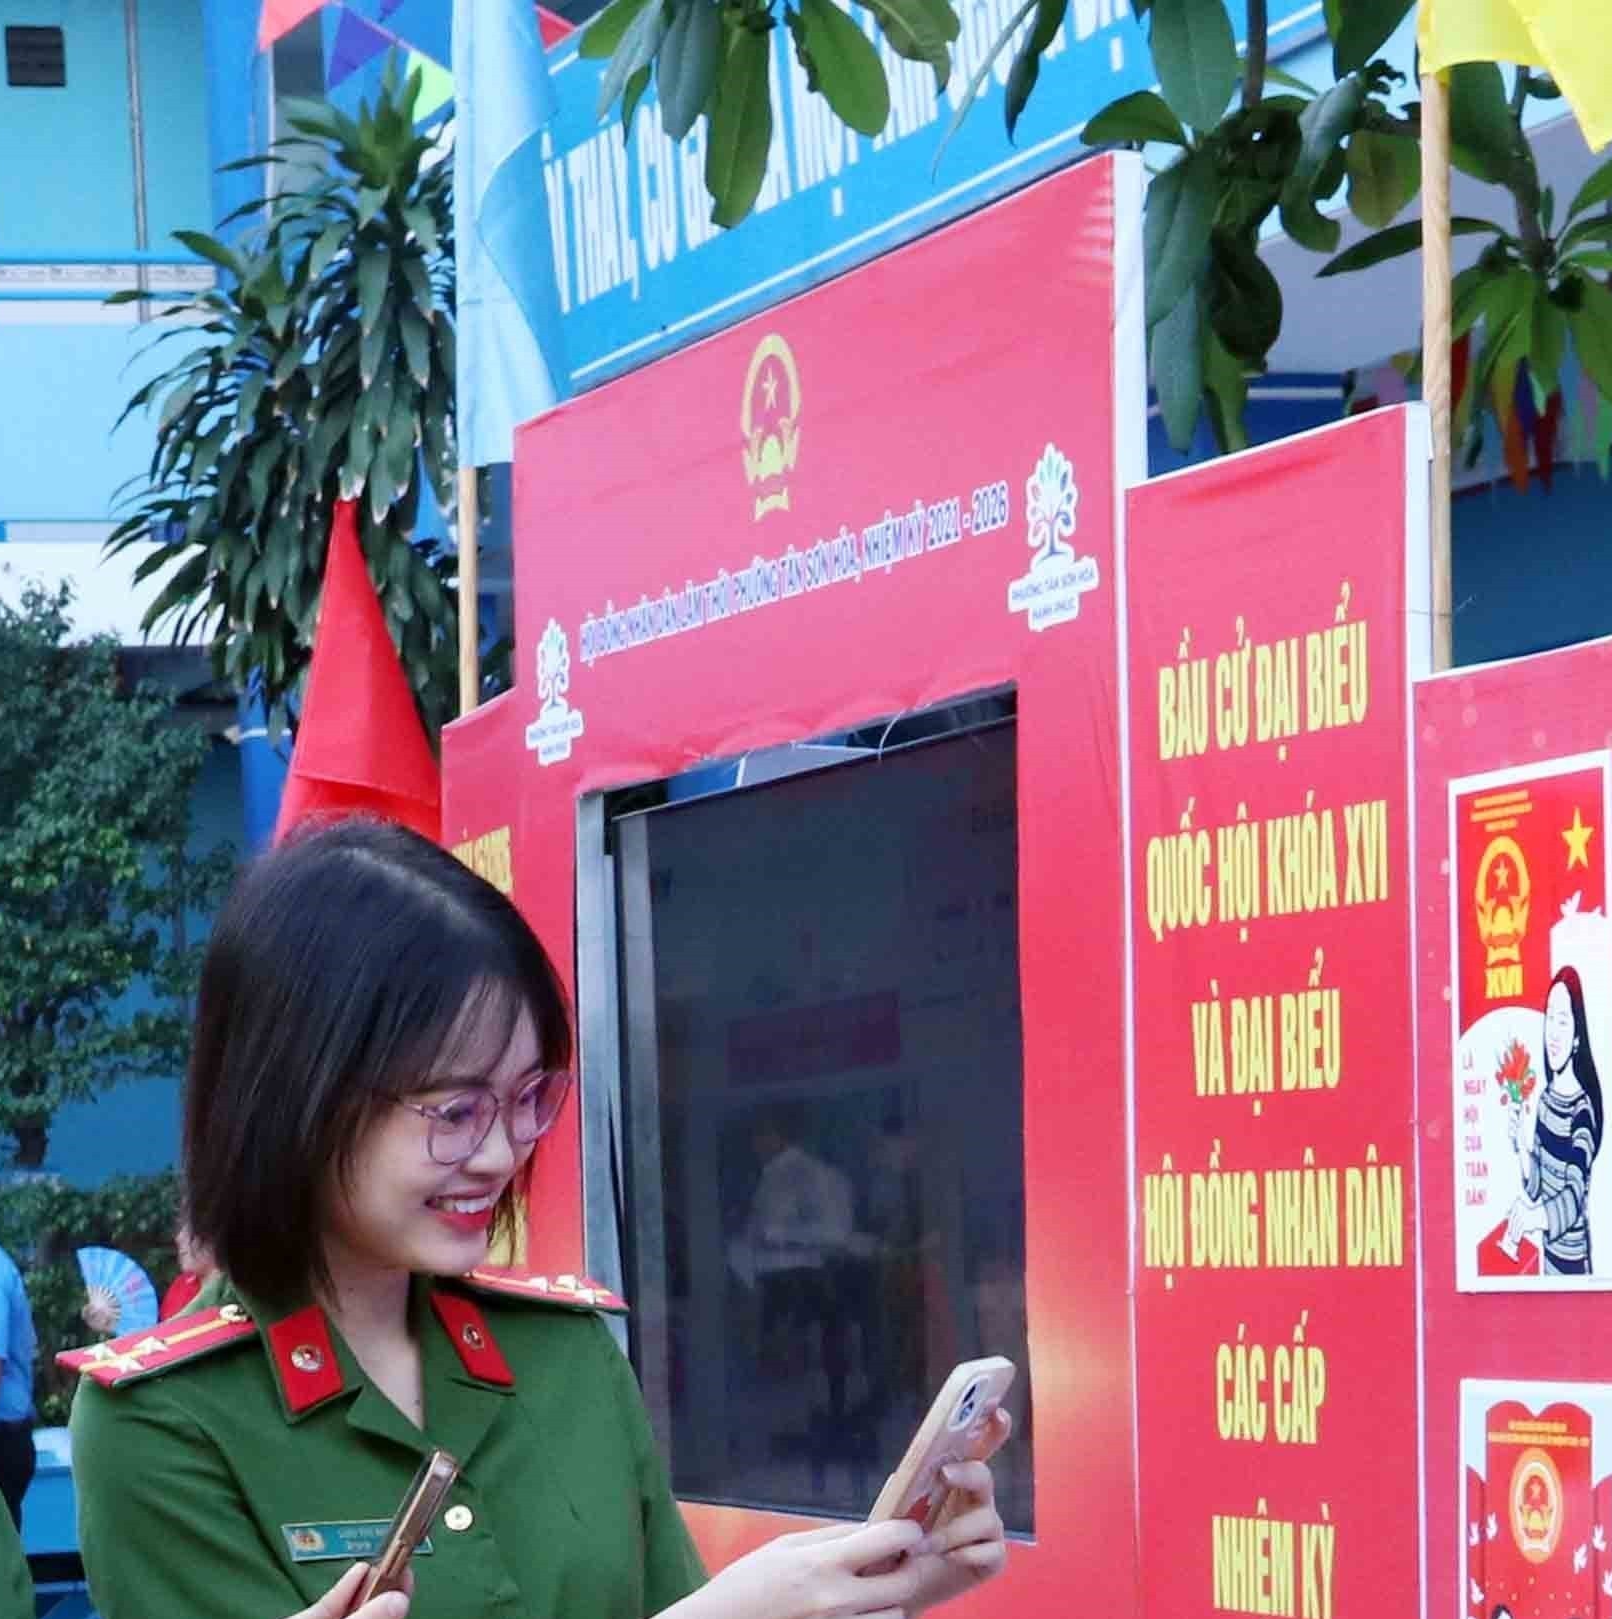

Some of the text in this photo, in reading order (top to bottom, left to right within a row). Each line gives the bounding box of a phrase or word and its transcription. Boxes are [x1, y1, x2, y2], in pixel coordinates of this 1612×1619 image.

[927, 497, 961, 550] 2021
[972, 480, 1008, 536] 2026
[1158, 581, 1368, 761] BẦU CỬ ĐẠI BIỂU
[1146, 789, 1388, 943] QUỐC HỘI KHÓA XVI
[1192, 947, 1341, 1116] VÀ ĐẠI BIỂU
[1485, 964, 1523, 999] XVI
[1143, 1137, 1403, 1290] HỘI ĐỒNG NHÂN DÂN
[1215, 1309, 1325, 1444] CÁC CẤP
